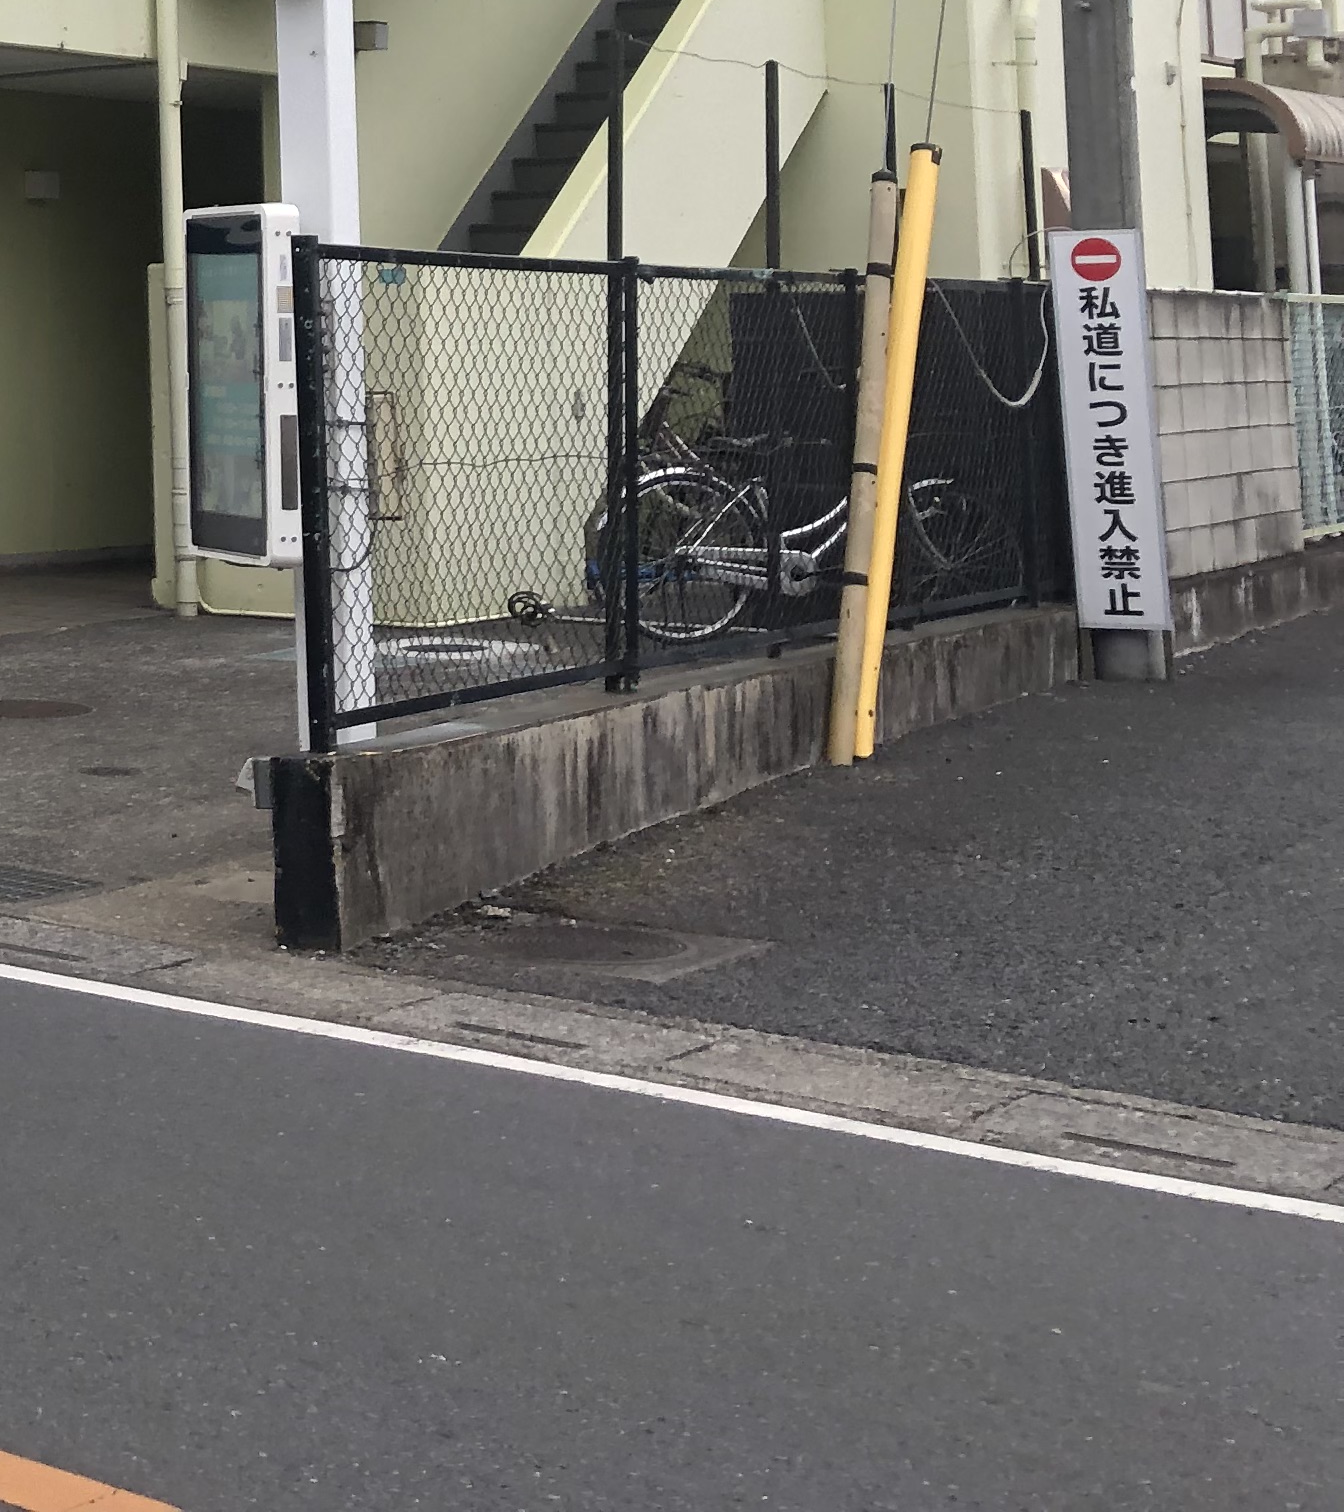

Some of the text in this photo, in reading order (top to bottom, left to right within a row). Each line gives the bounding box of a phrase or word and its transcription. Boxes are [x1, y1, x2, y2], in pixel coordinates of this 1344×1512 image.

[1079, 286, 1145, 617] 私道につき進入禁止
